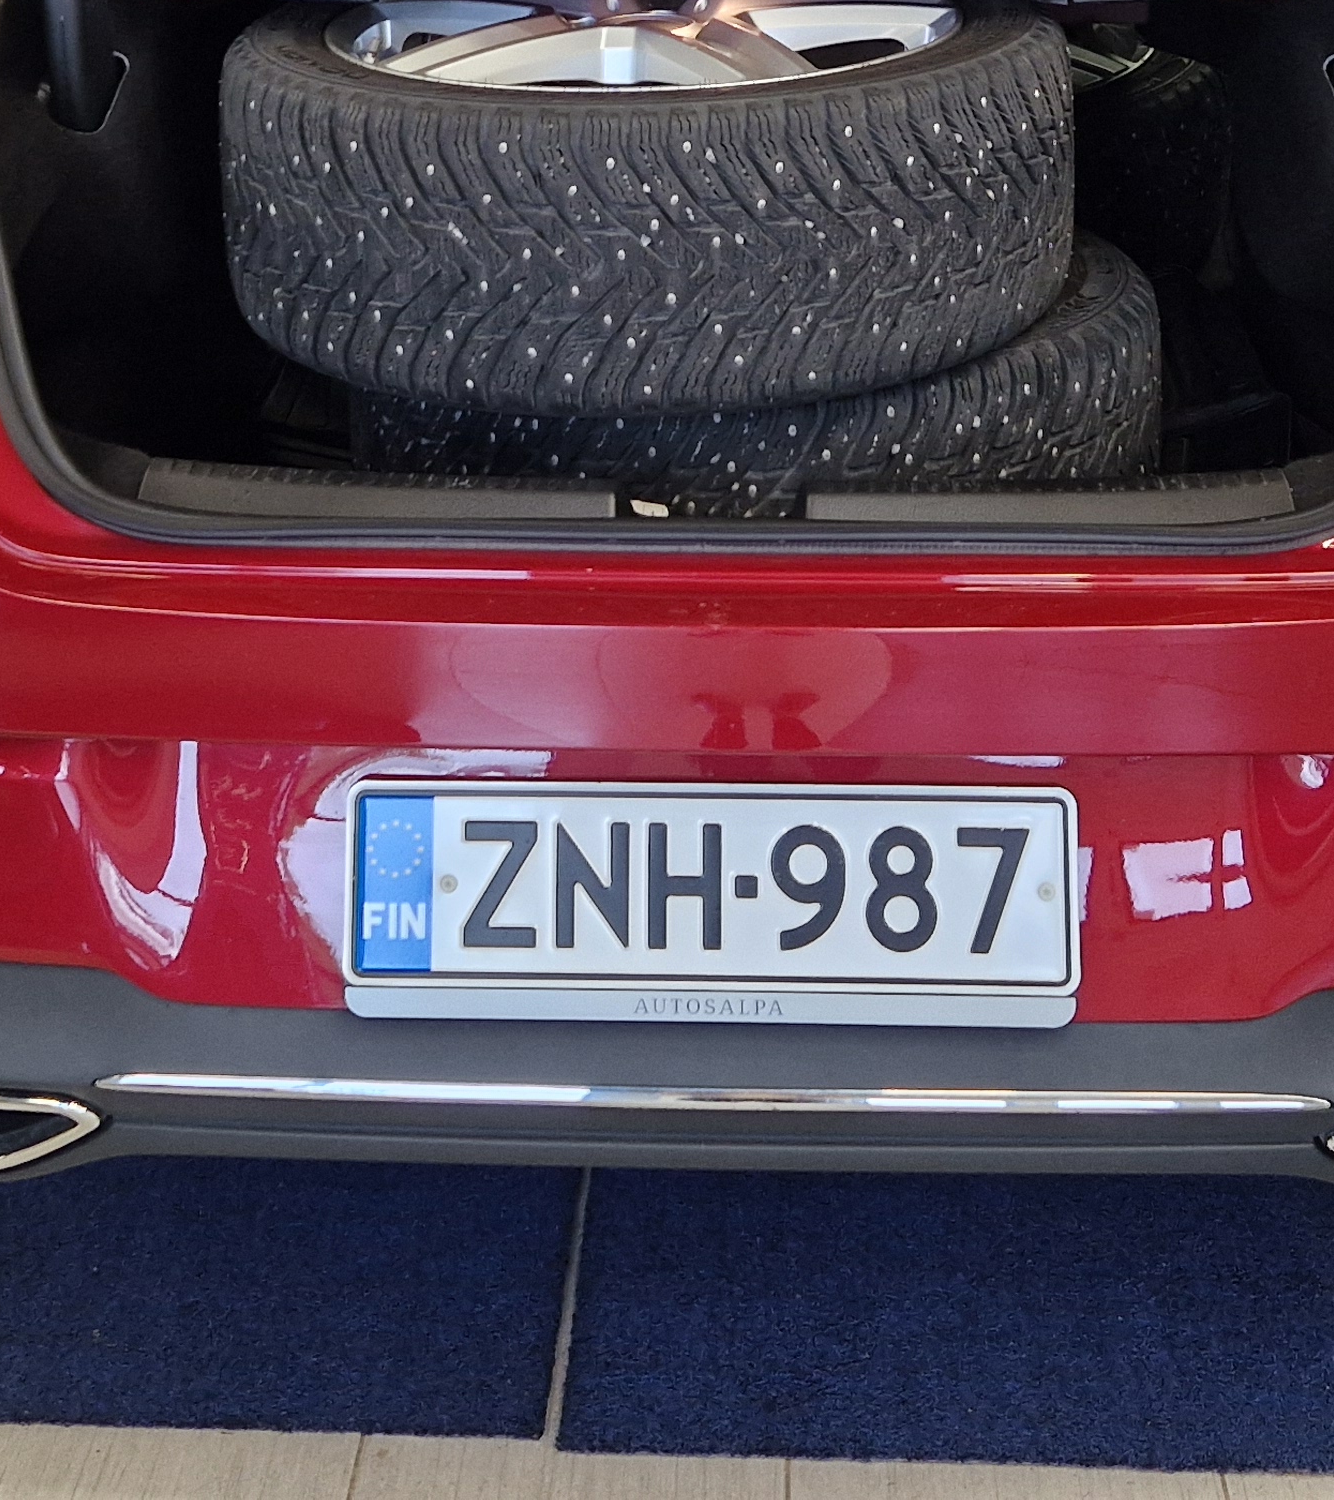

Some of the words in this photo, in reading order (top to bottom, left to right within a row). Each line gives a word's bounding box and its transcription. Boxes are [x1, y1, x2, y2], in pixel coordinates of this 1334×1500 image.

[463, 820, 1031, 955] ZNH-987
[362, 901, 427, 941] FIN
[633, 996, 785, 1018] AUTOSALPA
